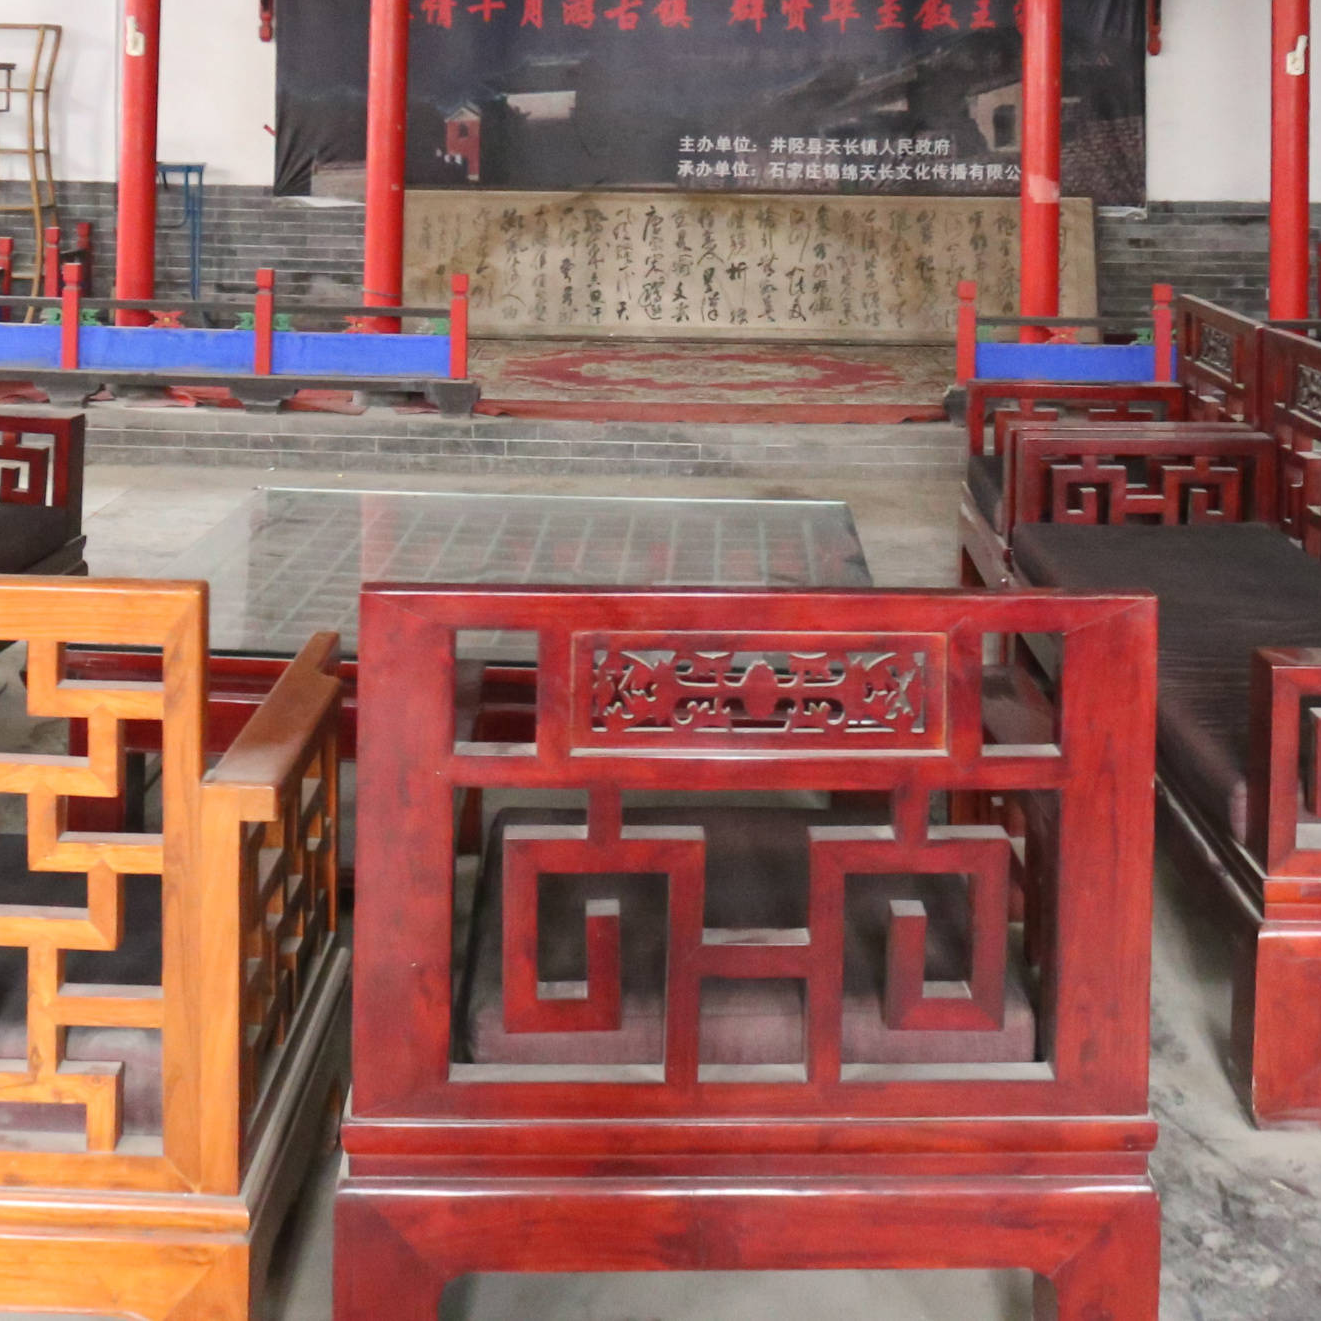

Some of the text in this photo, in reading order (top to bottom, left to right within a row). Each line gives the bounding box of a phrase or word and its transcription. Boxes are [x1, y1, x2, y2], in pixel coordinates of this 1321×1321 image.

[770, 137, 951, 156] 井陉县天长镇人民政府
